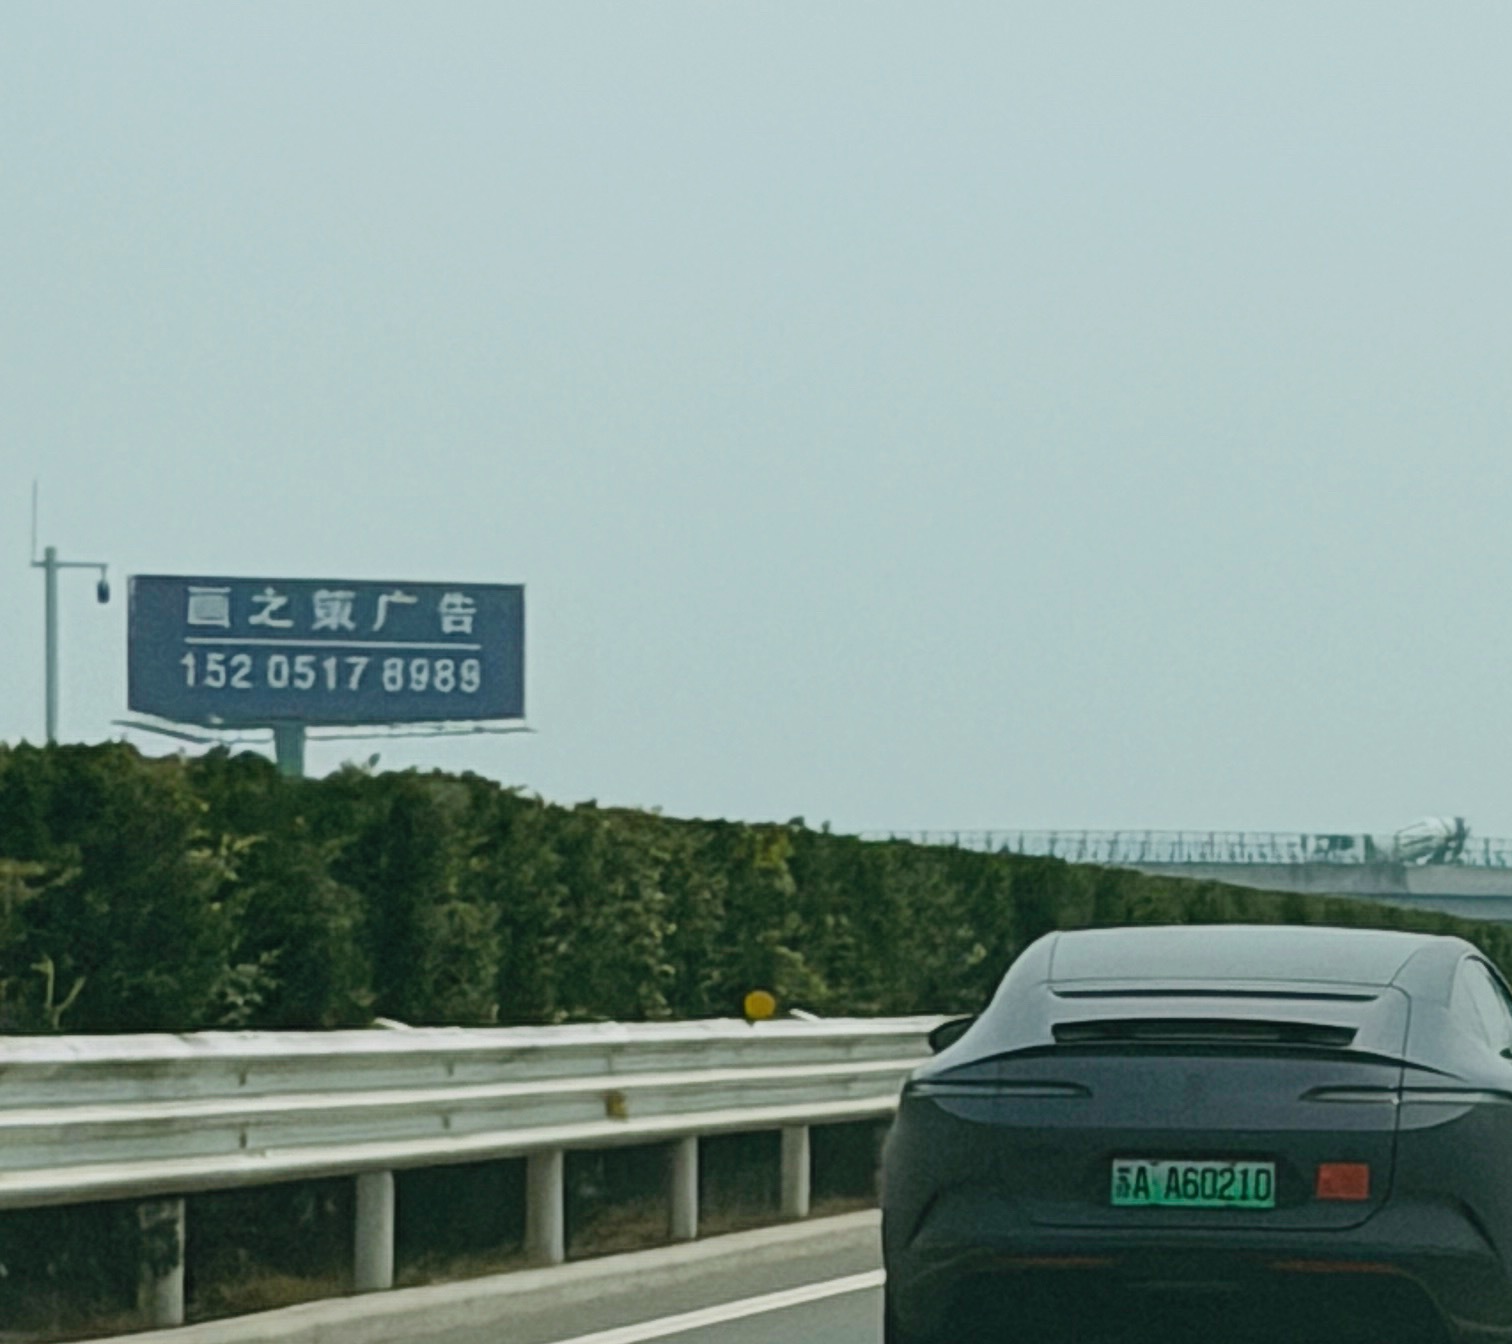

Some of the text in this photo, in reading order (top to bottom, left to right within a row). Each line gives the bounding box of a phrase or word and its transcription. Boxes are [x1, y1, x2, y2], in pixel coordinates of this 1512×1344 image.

[180, 651, 254, 689] 152
[266, 653, 371, 692] 0517
[1163, 1166, 1273, 1202] A60210
